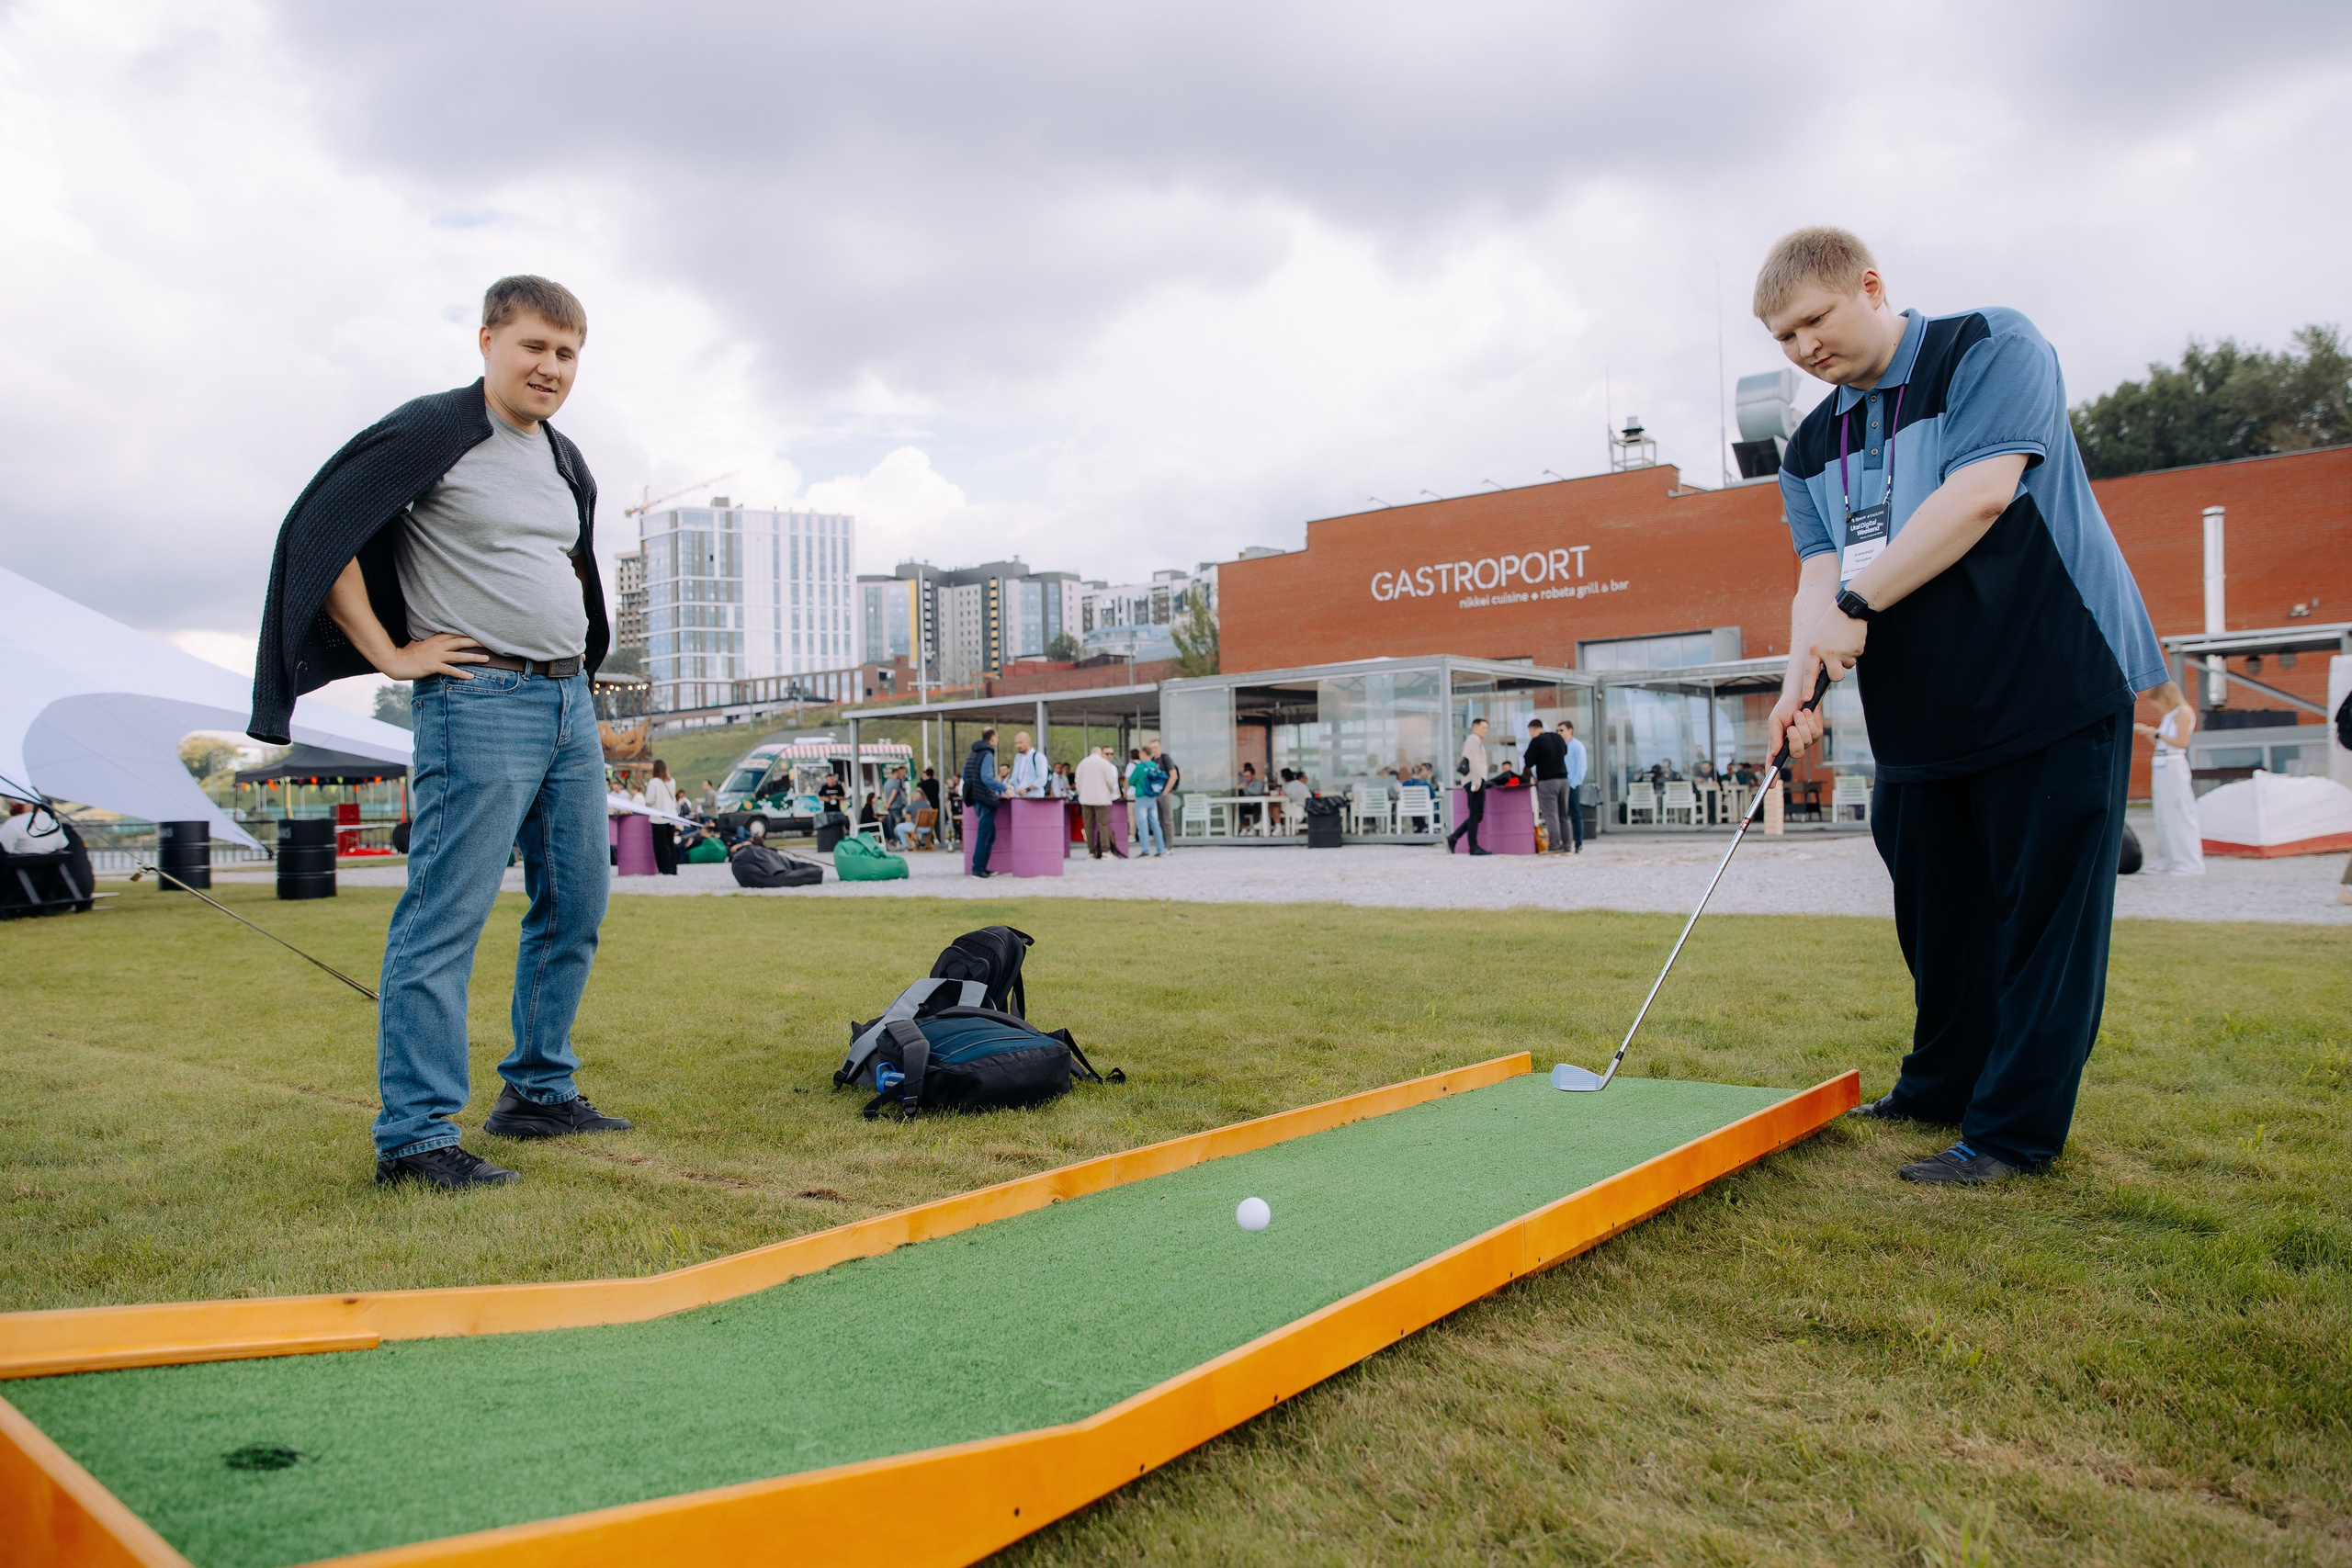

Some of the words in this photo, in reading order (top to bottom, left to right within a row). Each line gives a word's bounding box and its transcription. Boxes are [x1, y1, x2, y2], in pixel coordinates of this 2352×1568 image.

[1850, 523, 1860, 531] Ural
[1860, 519, 1877, 529] Digital
[1857, 525, 1880, 536] Weekend
[1371, 545, 1591, 602] GASTROPORT
[1459, 593, 1490, 609] nikkei
[1491, 591, 1529, 605] cuisine
[1540, 586, 1576, 600] robata
[1577, 581, 1600, 599] grill
[1610, 578, 1630, 592] bar
